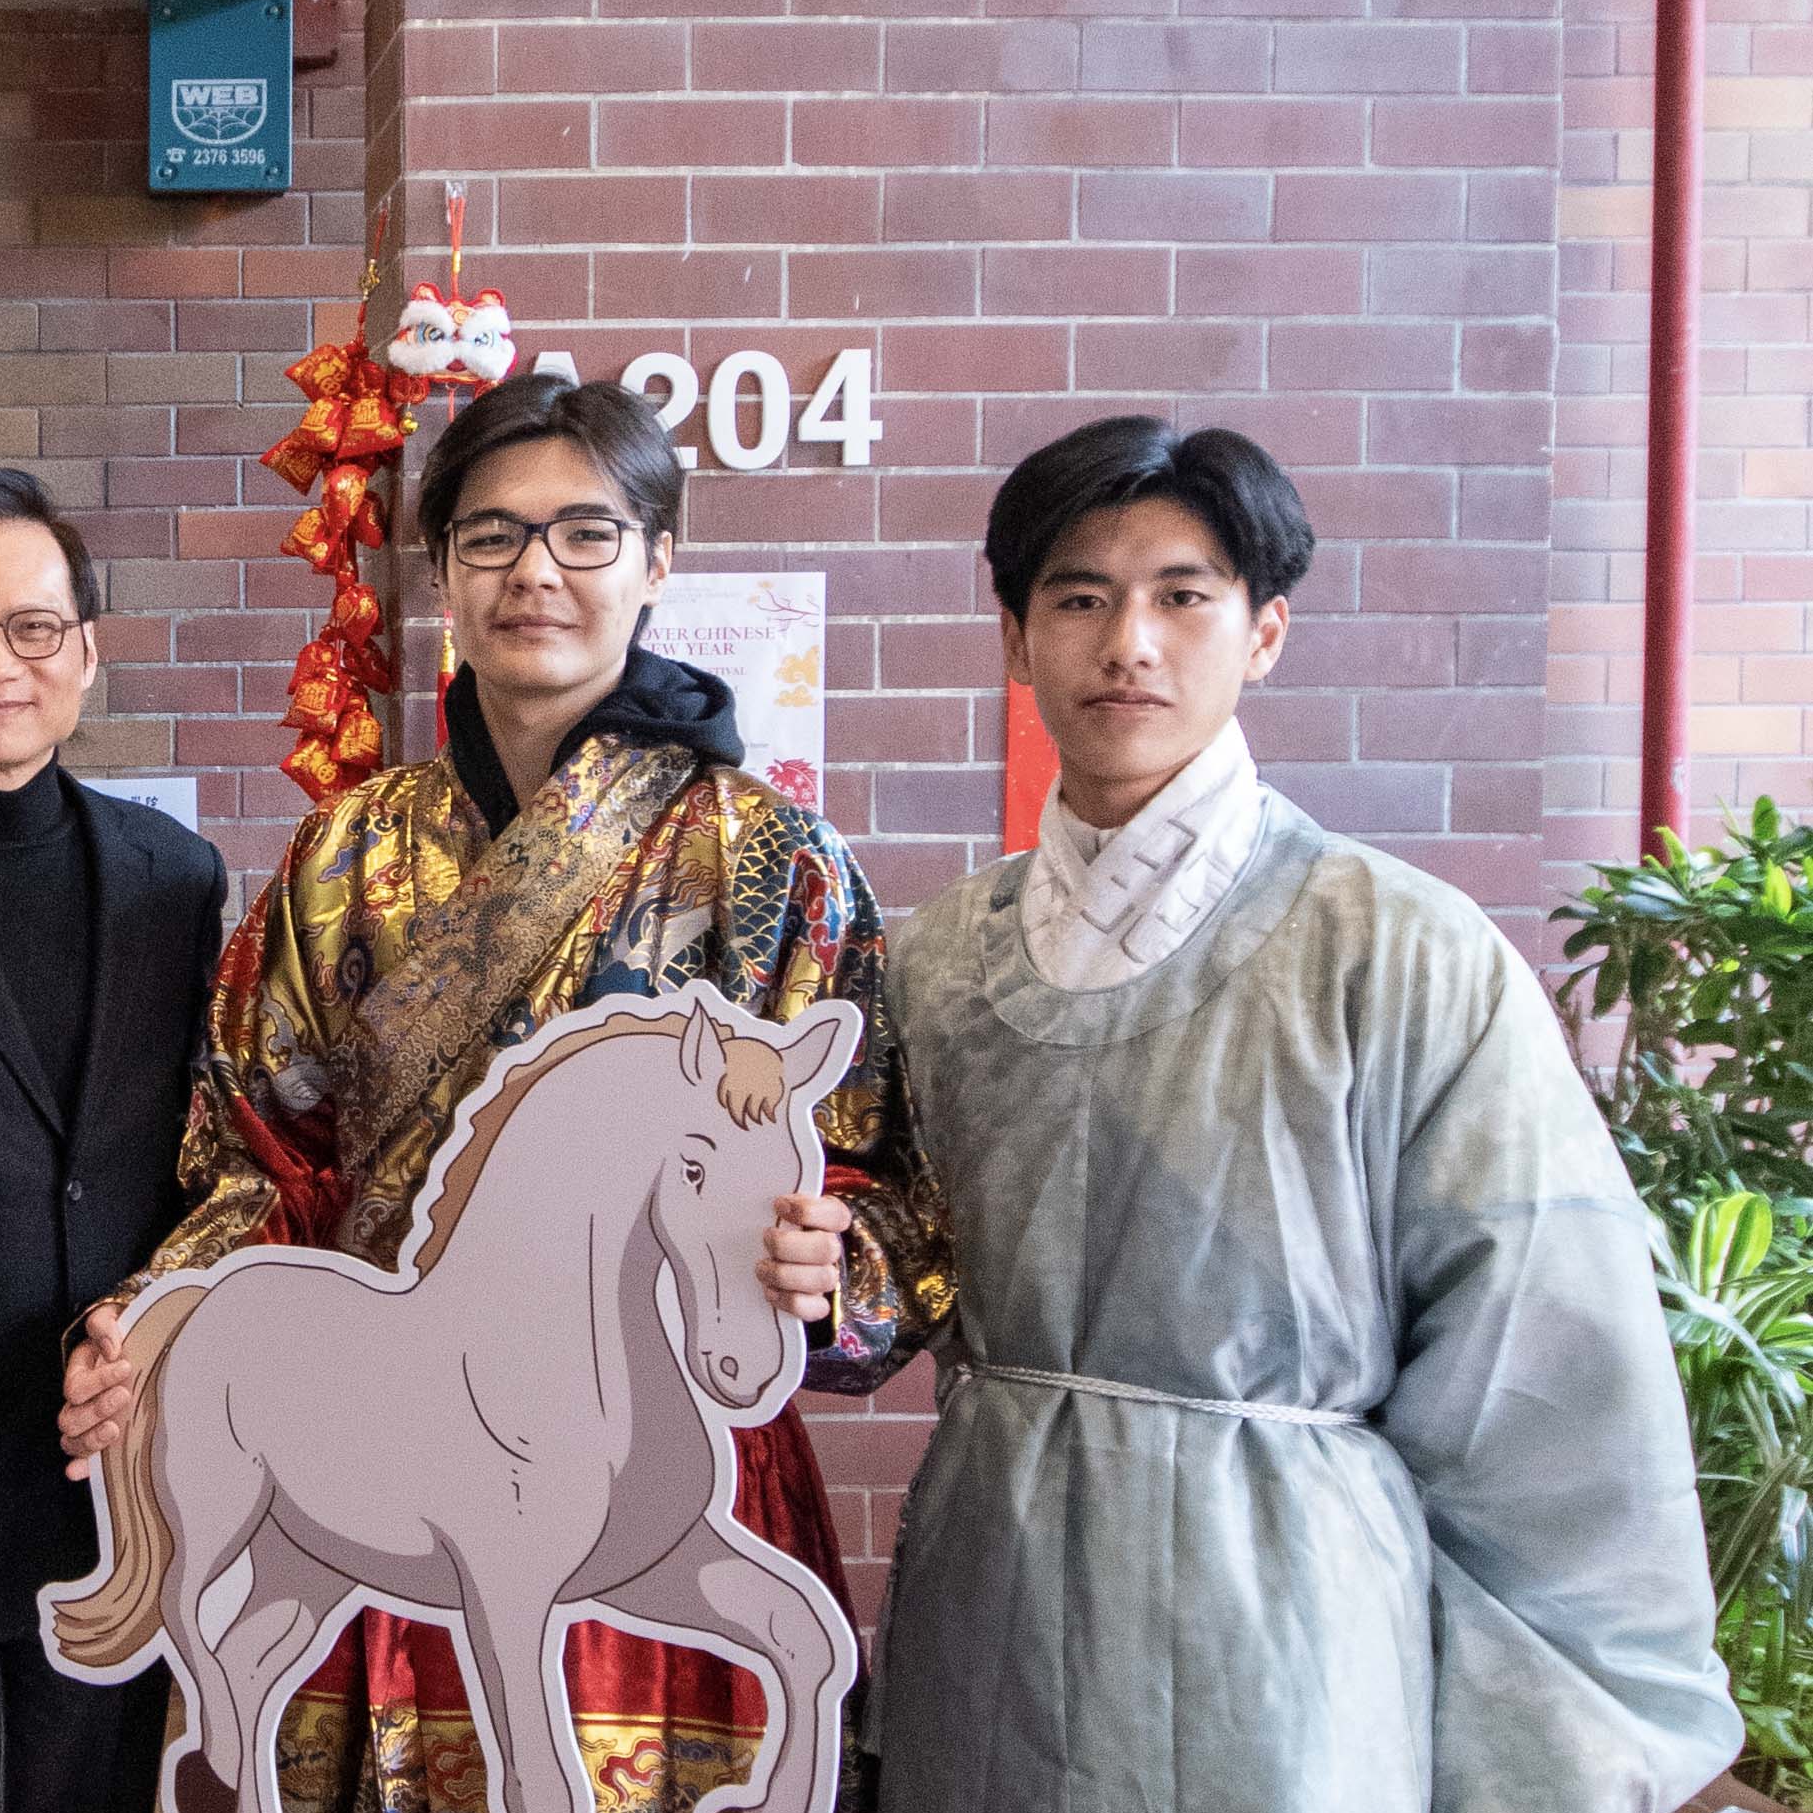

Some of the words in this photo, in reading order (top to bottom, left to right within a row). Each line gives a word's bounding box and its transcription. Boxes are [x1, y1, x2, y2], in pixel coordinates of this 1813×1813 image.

[180, 85, 259, 106] WEB
[193, 148, 227, 166] 2376
[231, 148, 266, 166] 3596
[694, 626, 775, 641] CHINESE
[686, 642, 736, 656] YEAR
